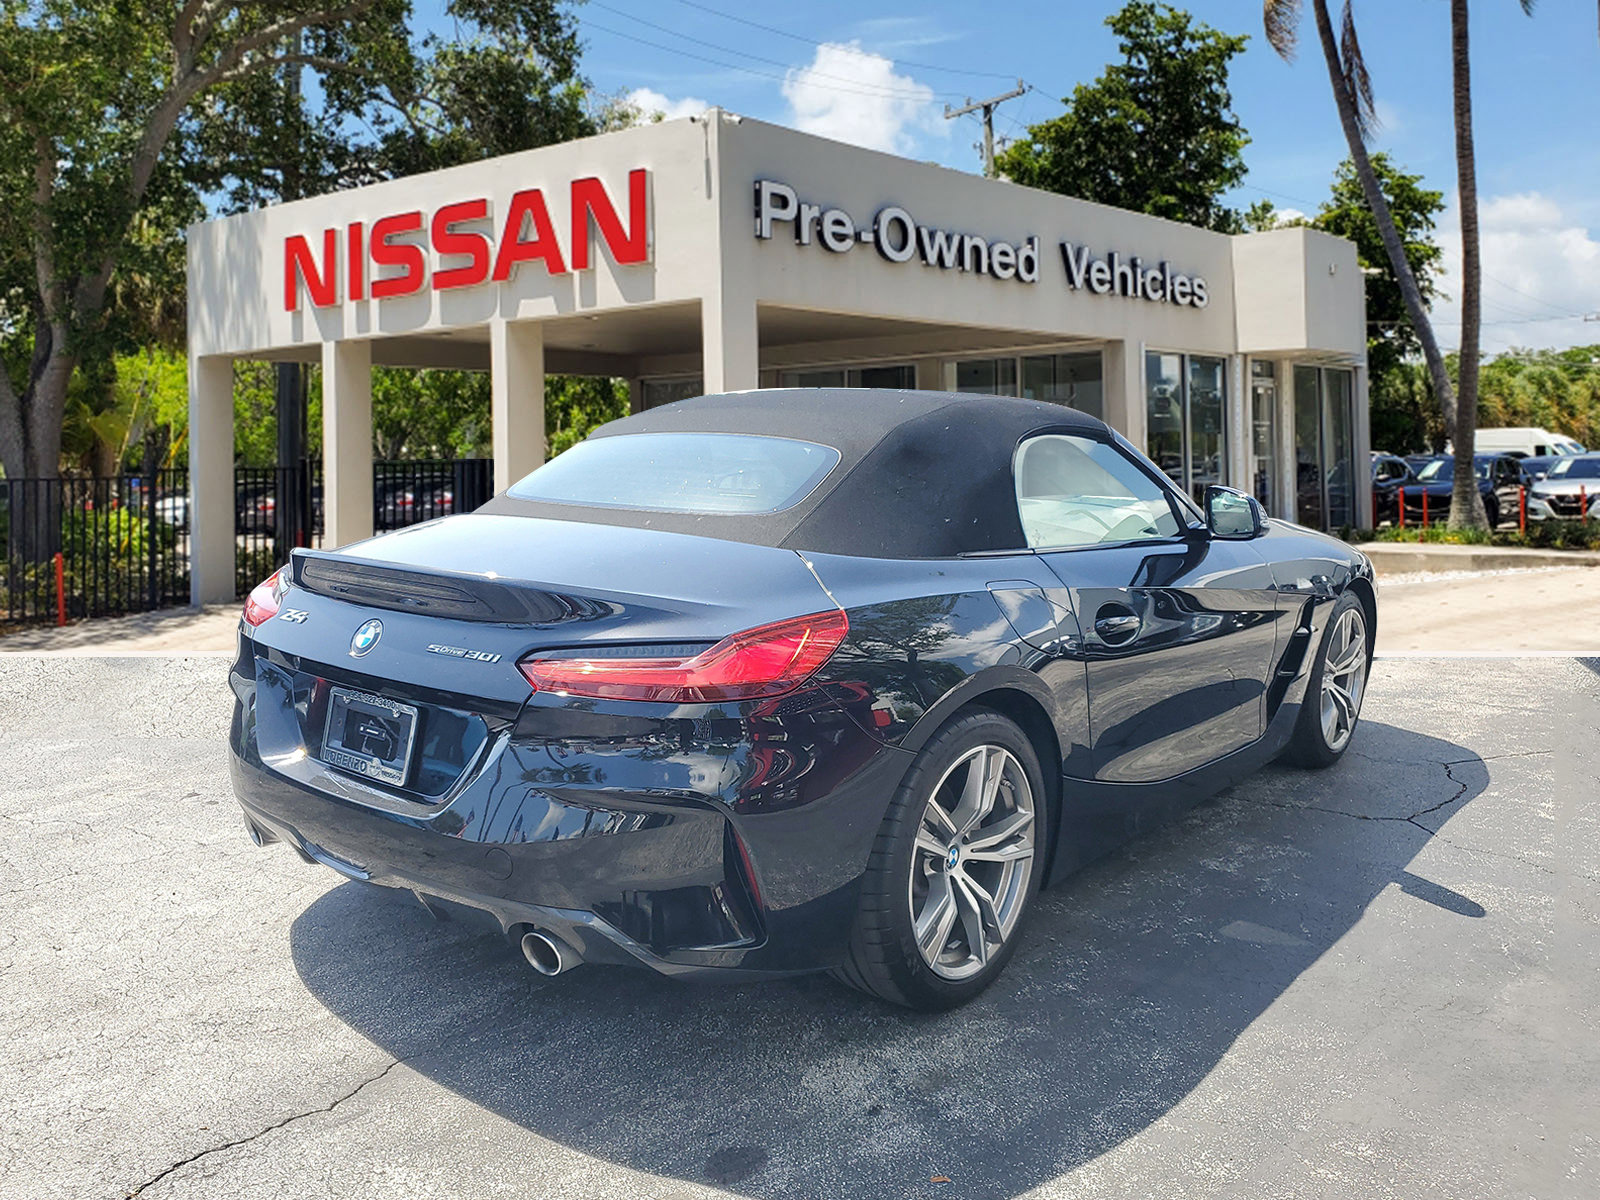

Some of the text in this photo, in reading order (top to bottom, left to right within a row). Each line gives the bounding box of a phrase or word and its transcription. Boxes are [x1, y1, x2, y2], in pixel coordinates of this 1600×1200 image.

[284, 167, 649, 312] NISSAN
[754, 179, 1209, 309] Pre-Owned Vehicles
[279, 607, 310, 625] Z4
